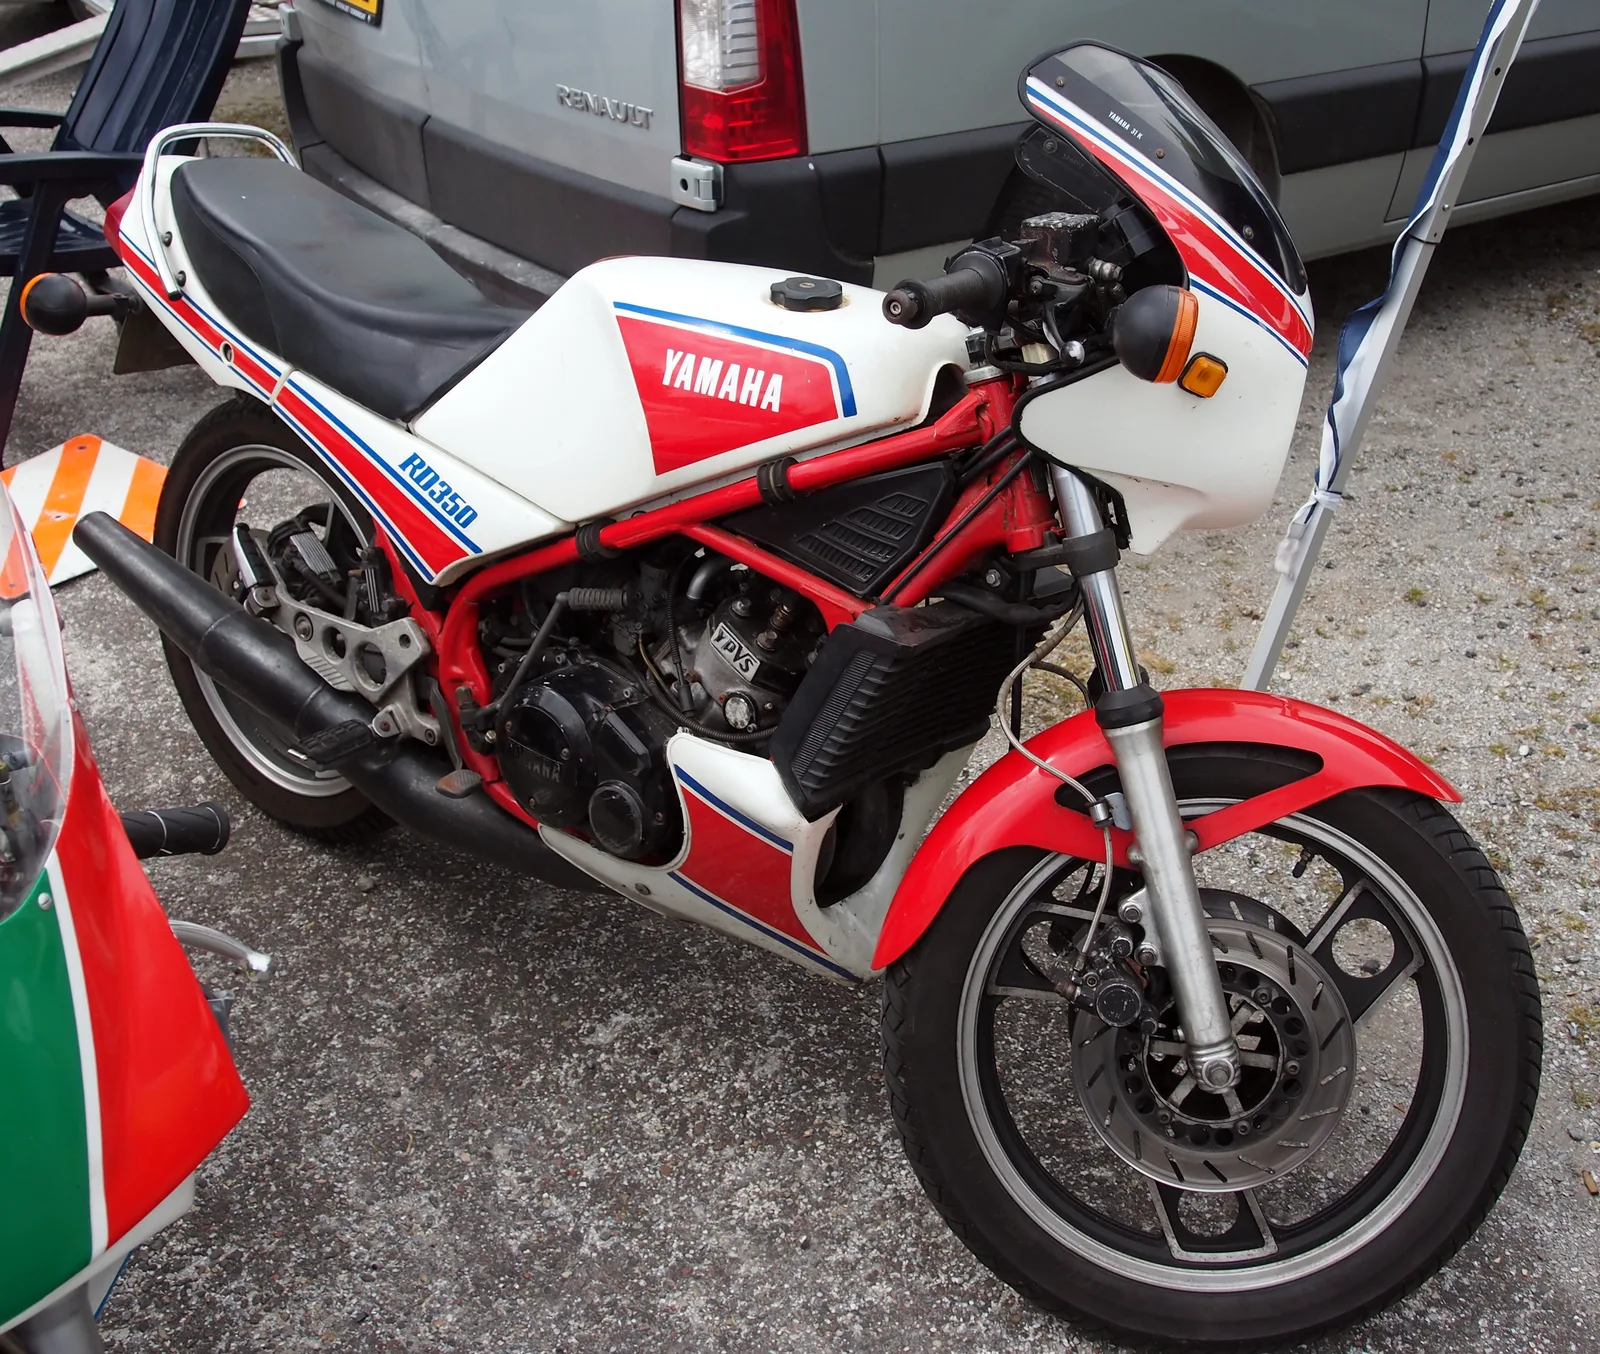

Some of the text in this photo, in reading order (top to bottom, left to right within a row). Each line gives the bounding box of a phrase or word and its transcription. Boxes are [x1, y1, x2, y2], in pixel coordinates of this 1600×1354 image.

[556, 83, 653, 129] RENAULT
[1108, 110, 1130, 130] YAMAHA
[662, 348, 783, 413] YAMAHA
[398, 452, 478, 529] RD350
[713, 626, 757, 673] YPVS
